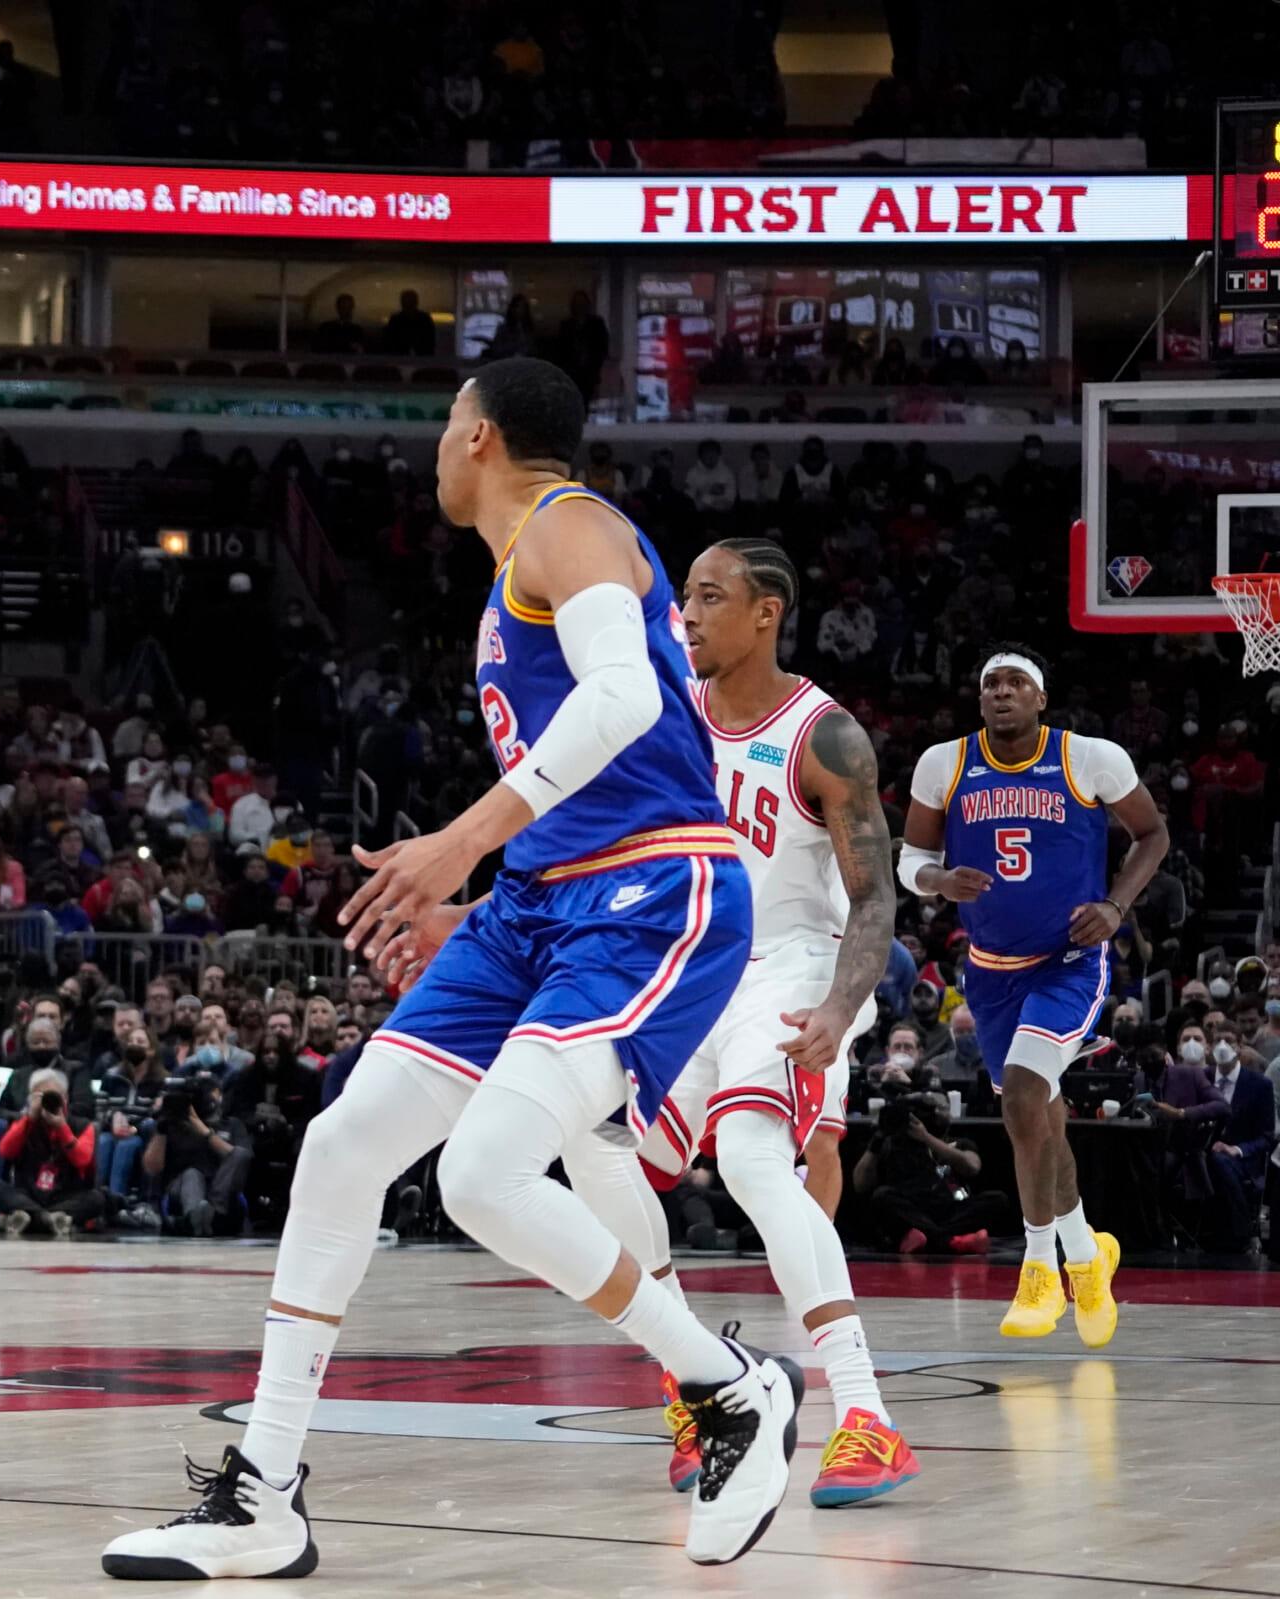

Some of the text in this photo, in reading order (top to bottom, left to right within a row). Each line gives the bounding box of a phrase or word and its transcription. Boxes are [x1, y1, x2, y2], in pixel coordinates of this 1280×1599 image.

[48, 181, 146, 211] Homes
[153, 185, 175, 212] &
[180, 185, 293, 215] Families
[299, 189, 376, 218] Since
[641, 186, 1088, 233] FIRST ALERT
[481, 682, 529, 777] 2
[960, 787, 1066, 824] WARRIORS
[995, 828, 1033, 882] 5
